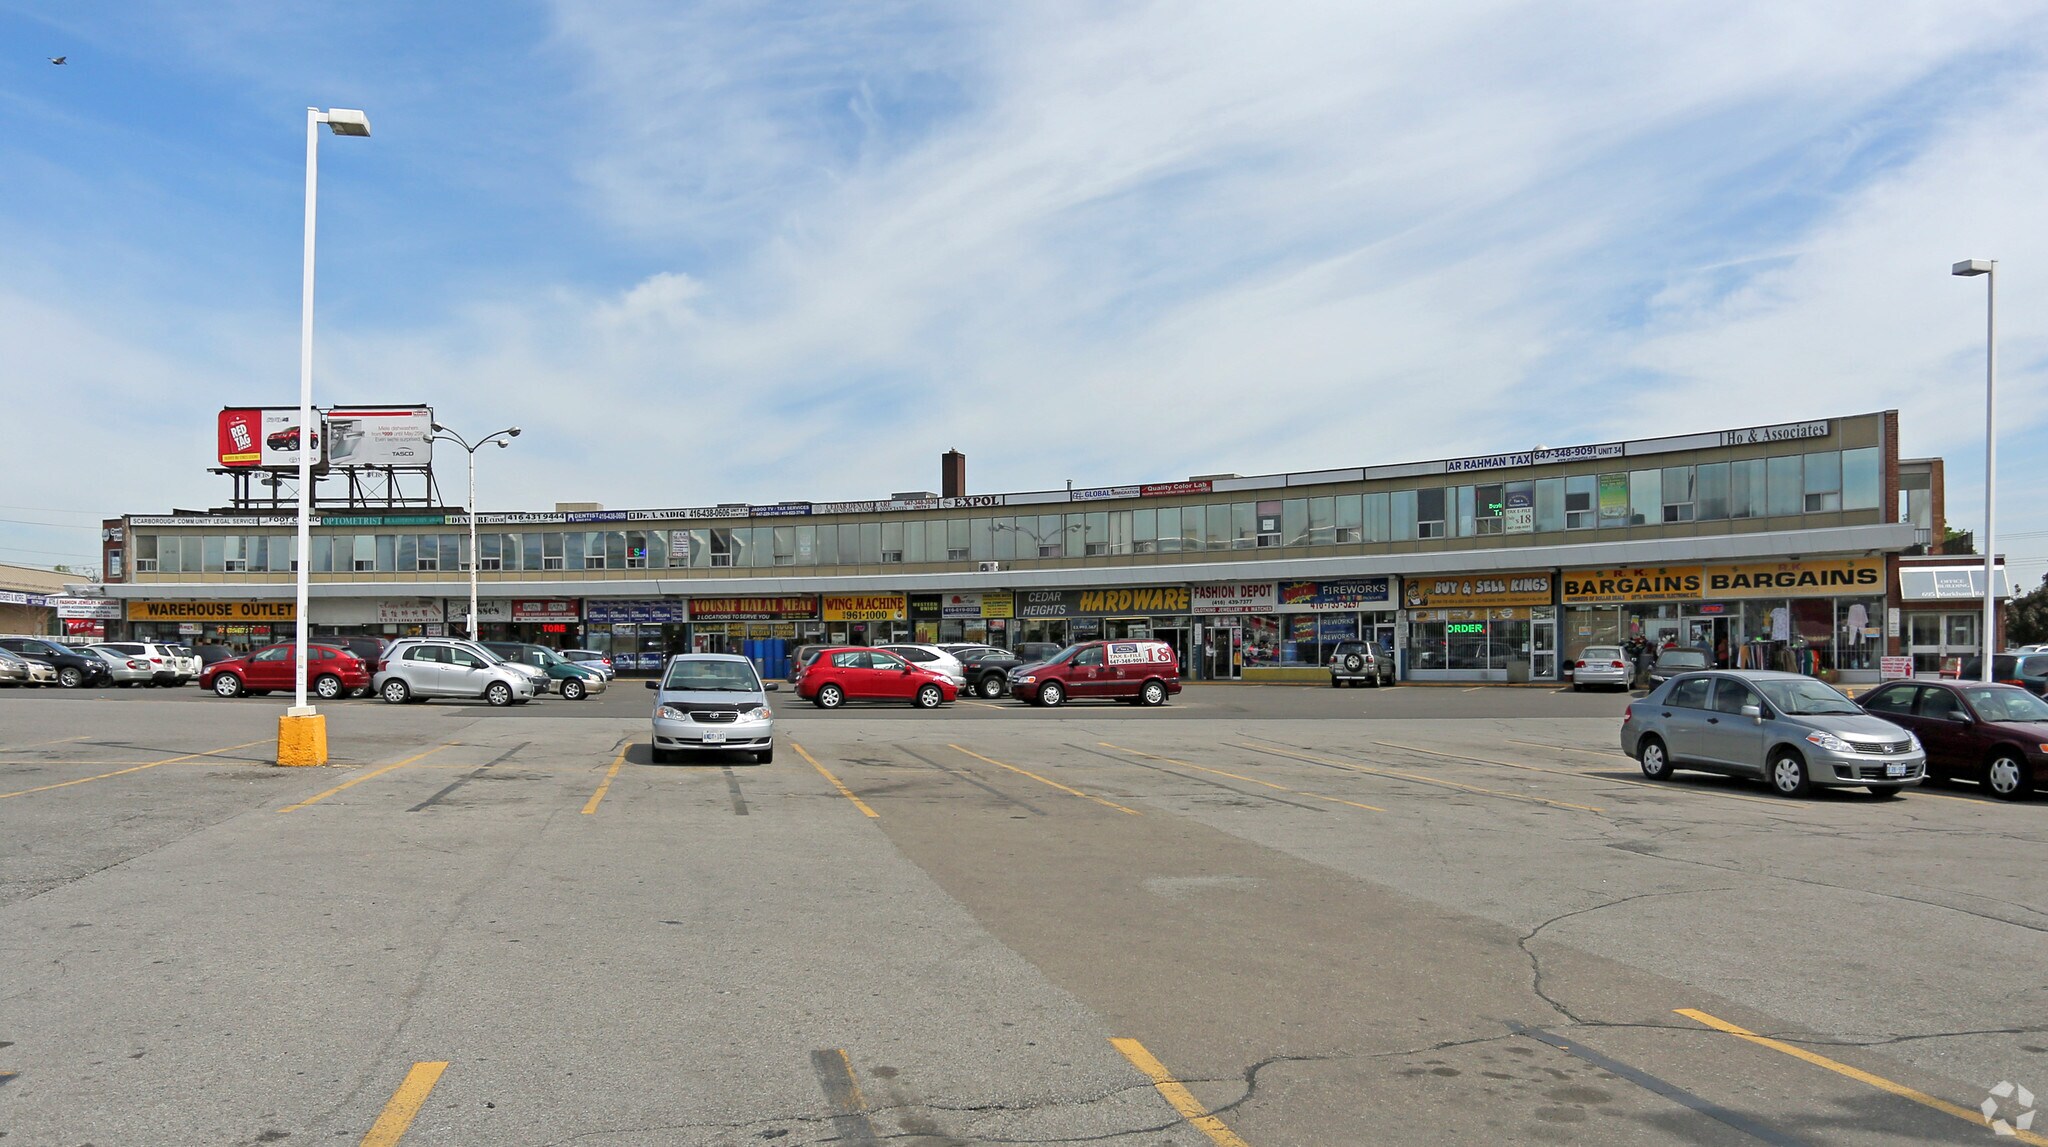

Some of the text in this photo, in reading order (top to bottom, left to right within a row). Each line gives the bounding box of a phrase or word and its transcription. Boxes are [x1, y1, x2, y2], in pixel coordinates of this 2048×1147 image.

[230, 424, 248, 438] RED
[1727, 424, 1825, 445] Ho & Associates
[234, 433, 251, 447] TAG
[1534, 446, 1597, 461] 647-348-9091
[1614, 446, 1622, 454] 34
[1448, 454, 1531, 472] AR RAHMAN TAX
[1084, 490, 1111, 498] GLOBAL
[954, 496, 999, 508] EXPOL
[660, 511, 686, 519] SADIQ
[689, 508, 730, 518] 416-438-0606
[322, 516, 383, 526] OPTOMETRIST
[1565, 575, 1700, 595] BARGAINS
[1711, 568, 1877, 589] BARGAINS
[1194, 585, 1236, 599] FASHION
[1241, 584, 1272, 598] DEPOT
[1322, 584, 1387, 595] FIREWORKS
[1434, 578, 1549, 594] BUY & SELL KINGS
[826, 597, 904, 610] WING MACHINE
[1028, 592, 1062, 603] CEDAR
[1079, 588, 1190, 612] HARDWARE
[148, 604, 293, 615] WAREHOUSE OUTLET
[694, 599, 812, 612] YOUSAF HALAL MEAT
[1023, 604, 1066, 616] HEIGHTS
[542, 624, 566, 632] TORE
[1447, 624, 1483, 633] ORDER
[1145, 647, 1170, 663] 18
